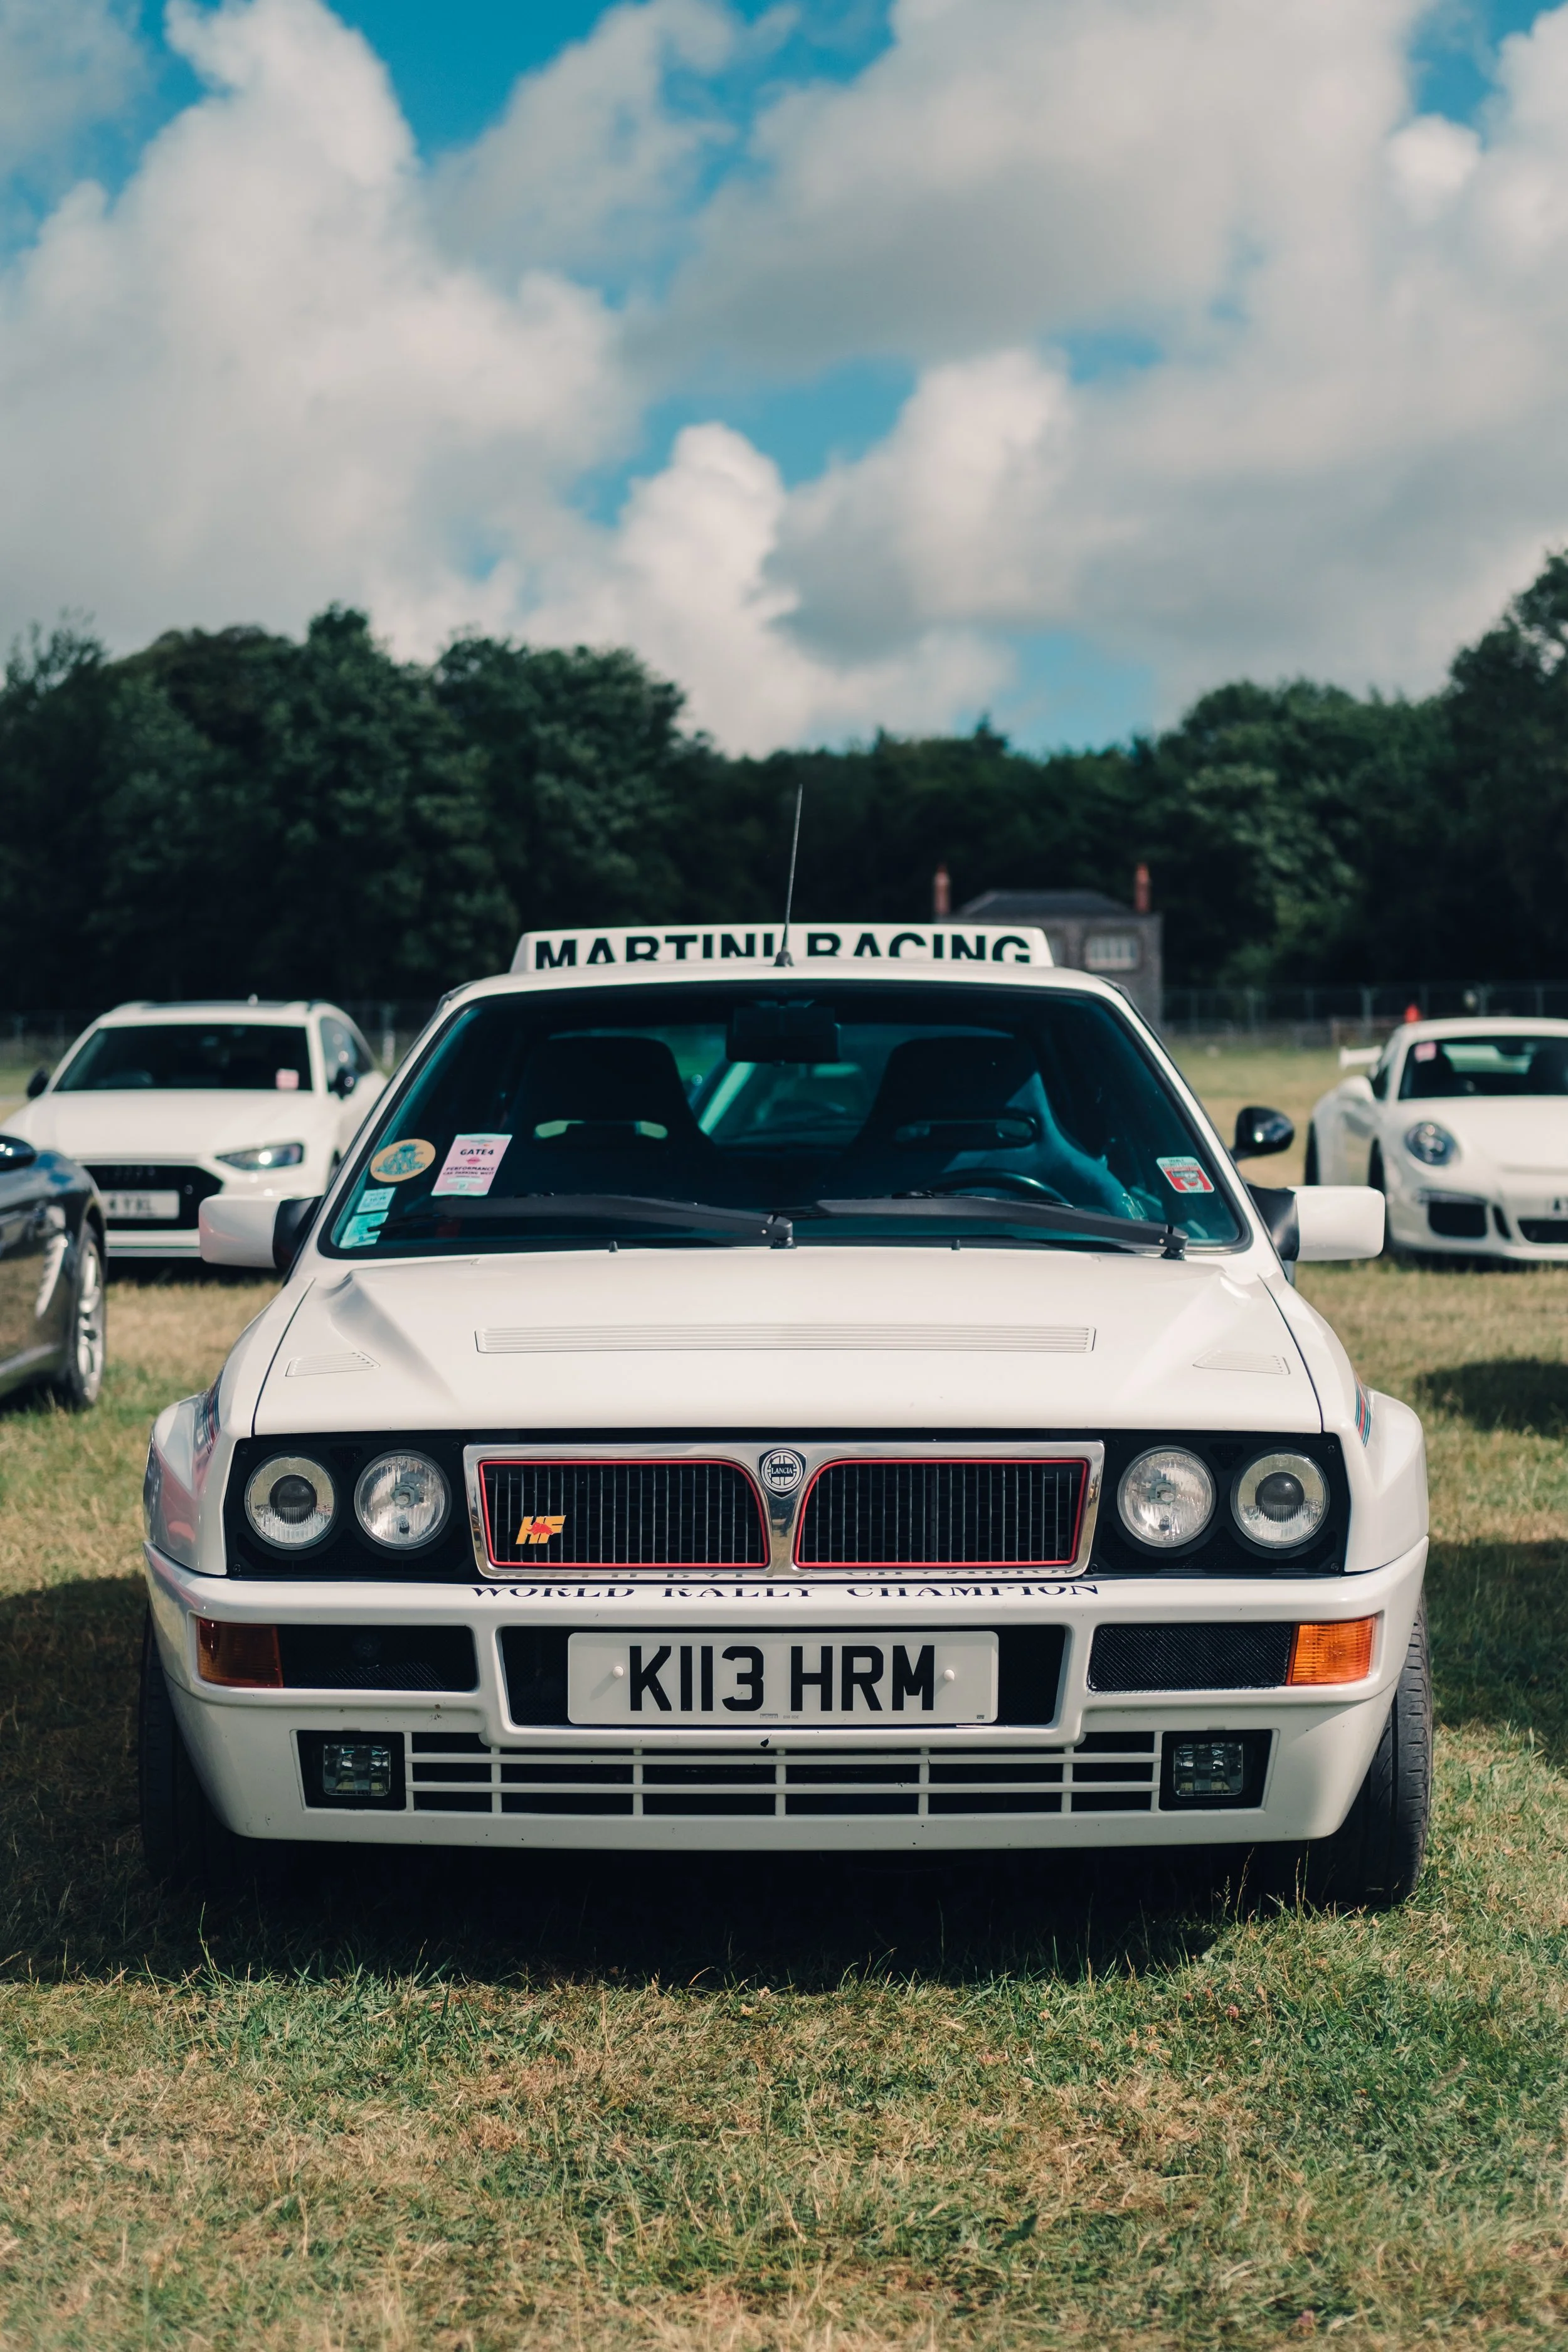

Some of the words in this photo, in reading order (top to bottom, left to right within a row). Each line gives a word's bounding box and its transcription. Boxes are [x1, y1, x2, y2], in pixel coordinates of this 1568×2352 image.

[535, 933, 775, 970] MARTINI
[807, 932, 1030, 963] RACING
[515, 1515, 566, 1545] HF
[471, 1587, 635, 1597] WORLD
[662, 1587, 817, 1597] RALLY
[846, 1584, 1099, 1597] CHAMPION
[628, 1645, 765, 1712] K113
[790, 1644, 936, 1712] HRM
